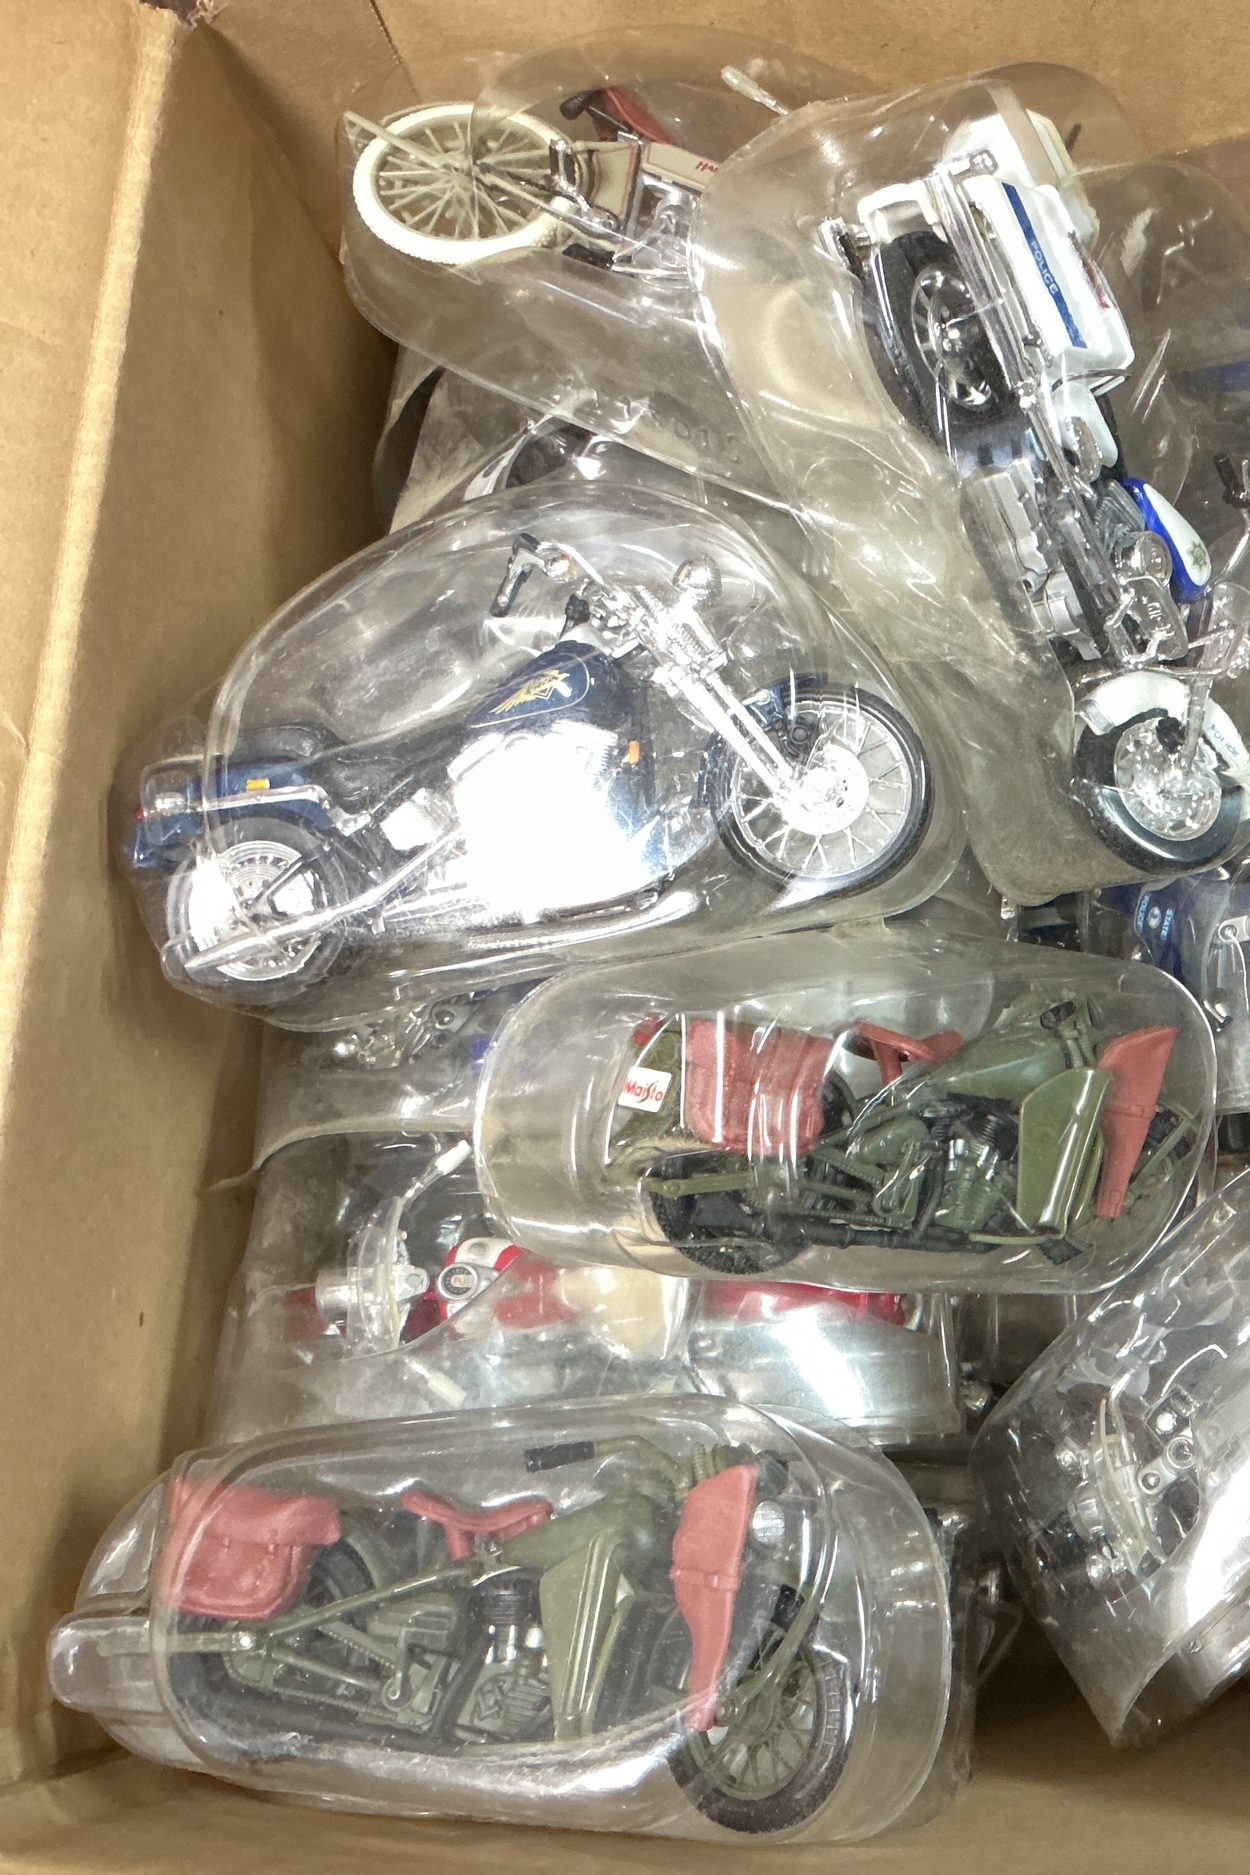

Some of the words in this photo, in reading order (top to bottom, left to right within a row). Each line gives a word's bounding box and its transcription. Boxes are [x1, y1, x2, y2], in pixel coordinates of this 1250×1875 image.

[1031, 240, 1059, 295] POLICE
[1161, 908, 1173, 937] STATE
[623, 1079, 664, 1103] Maisto
